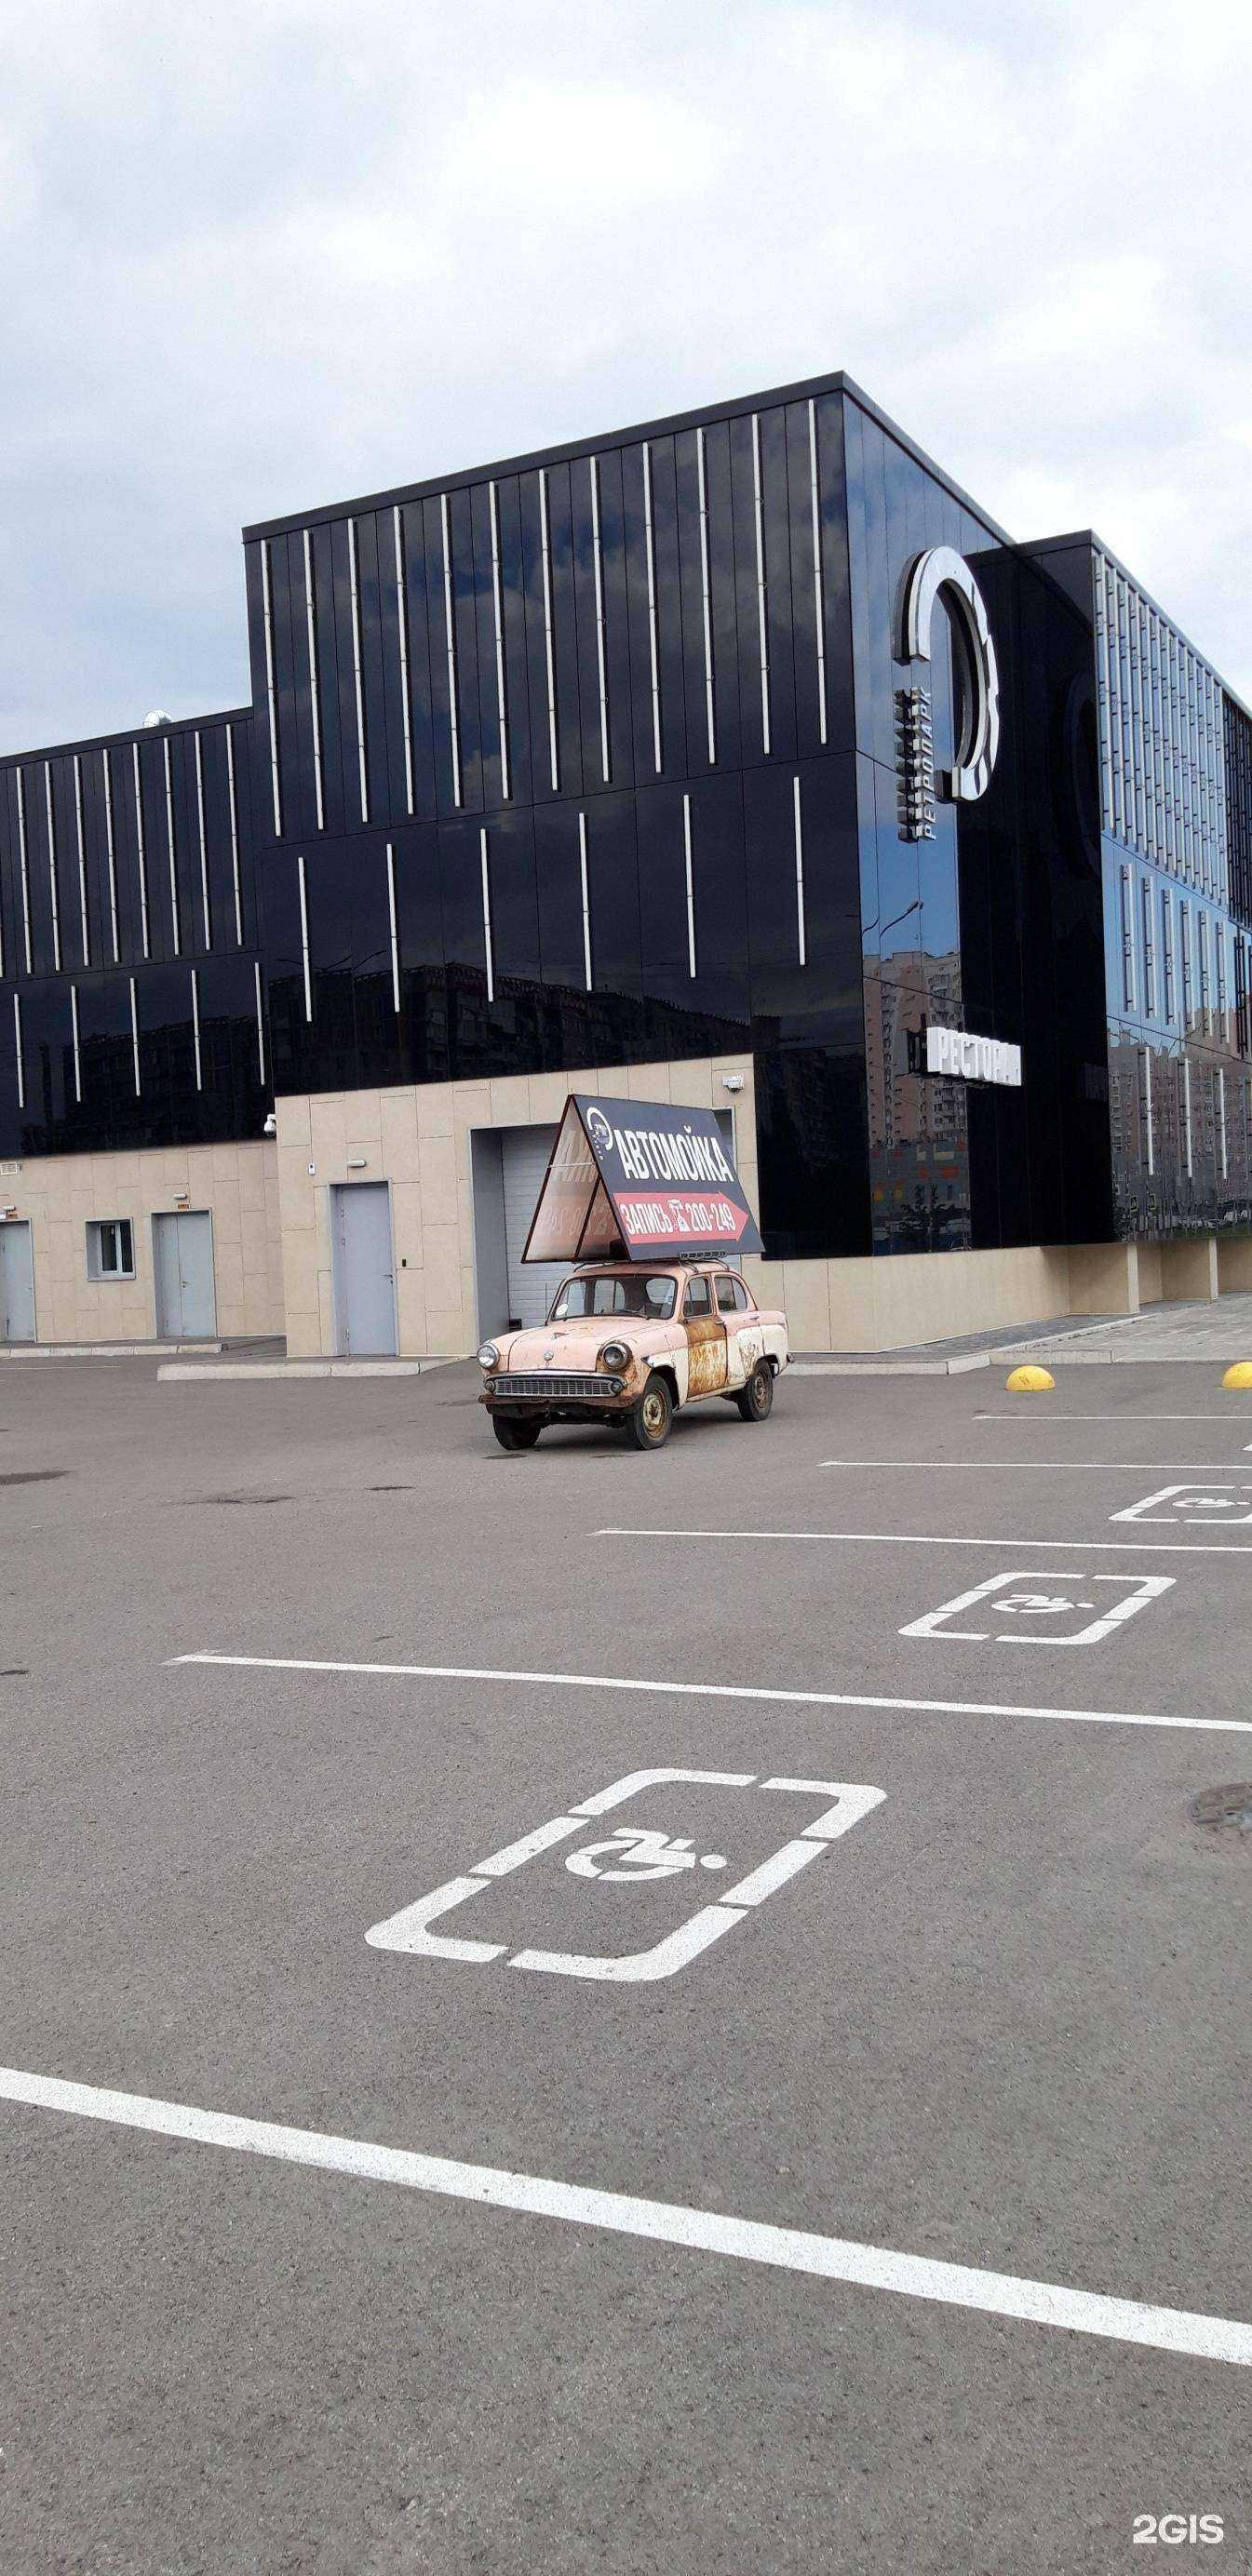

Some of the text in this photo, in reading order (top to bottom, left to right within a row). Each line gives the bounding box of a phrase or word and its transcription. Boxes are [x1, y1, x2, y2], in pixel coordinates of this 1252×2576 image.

[911, 686, 937, 842] РЕТРОПАРК
[613, 1124, 734, 1182] АВТОМОЙКА
[619, 1202, 674, 1235] ЗАПИСЬ
[685, 1202, 736, 1232] 200-249
